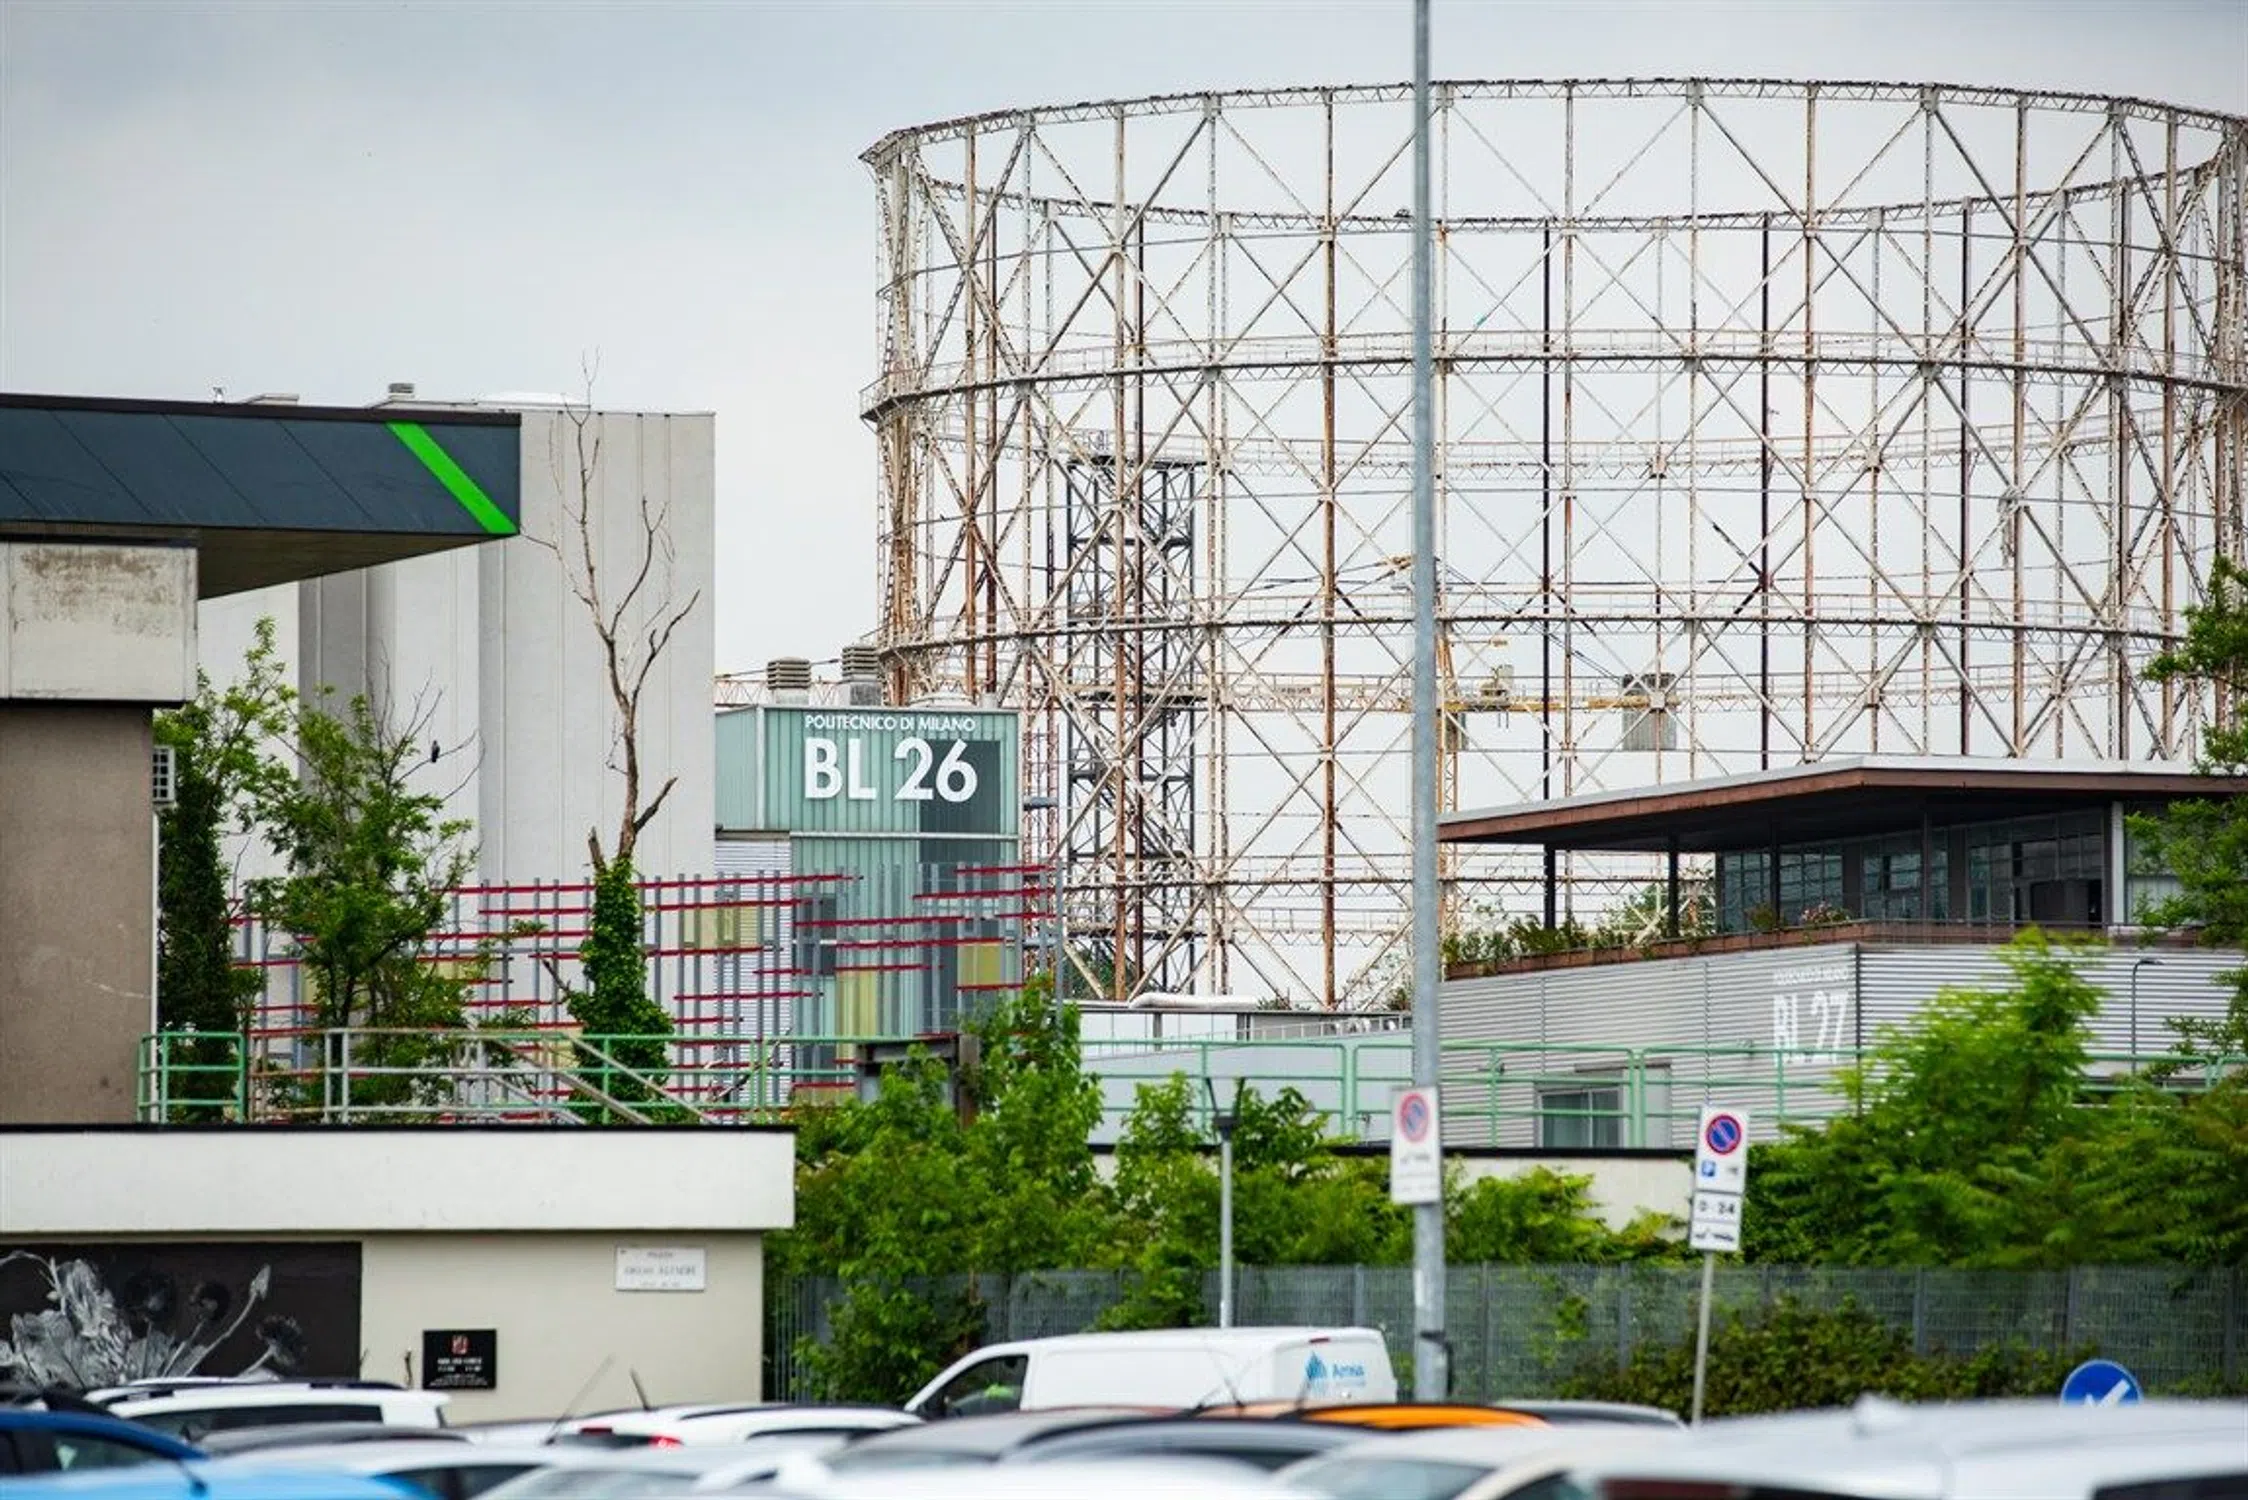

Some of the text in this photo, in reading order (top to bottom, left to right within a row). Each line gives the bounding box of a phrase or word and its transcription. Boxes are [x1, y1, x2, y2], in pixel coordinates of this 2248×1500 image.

[804, 714, 977, 732] POLITECNICO DI MILANO
[804, 736, 978, 802] BL 26
[1773, 989, 1849, 1067] BL 27
